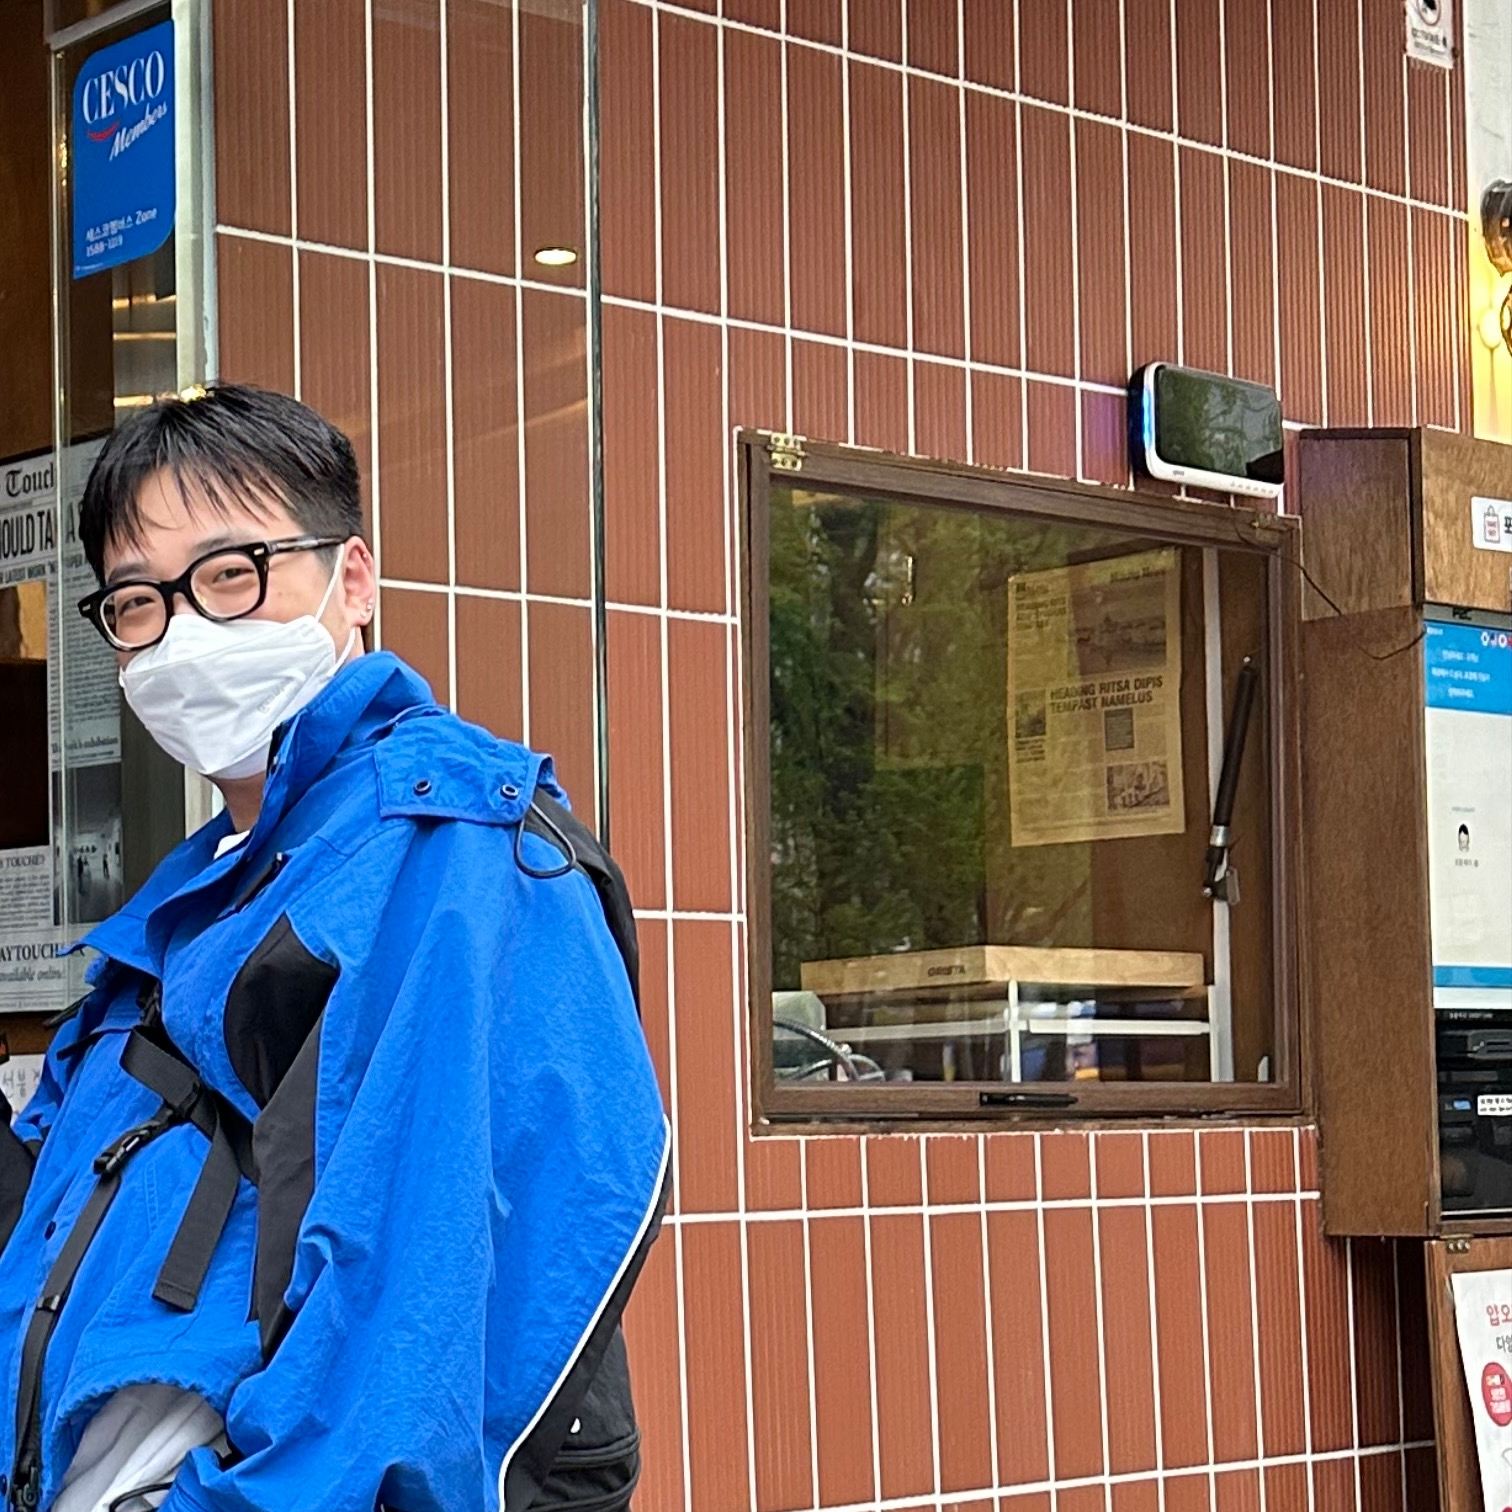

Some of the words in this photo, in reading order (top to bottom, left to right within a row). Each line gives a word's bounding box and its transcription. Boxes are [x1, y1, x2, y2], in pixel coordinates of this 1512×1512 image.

[82, 50, 165, 125] CESCO
[109, 101, 168, 162] Members
[135, 207, 157, 226] Zone
[1050, 683, 1096, 700] HEADING
